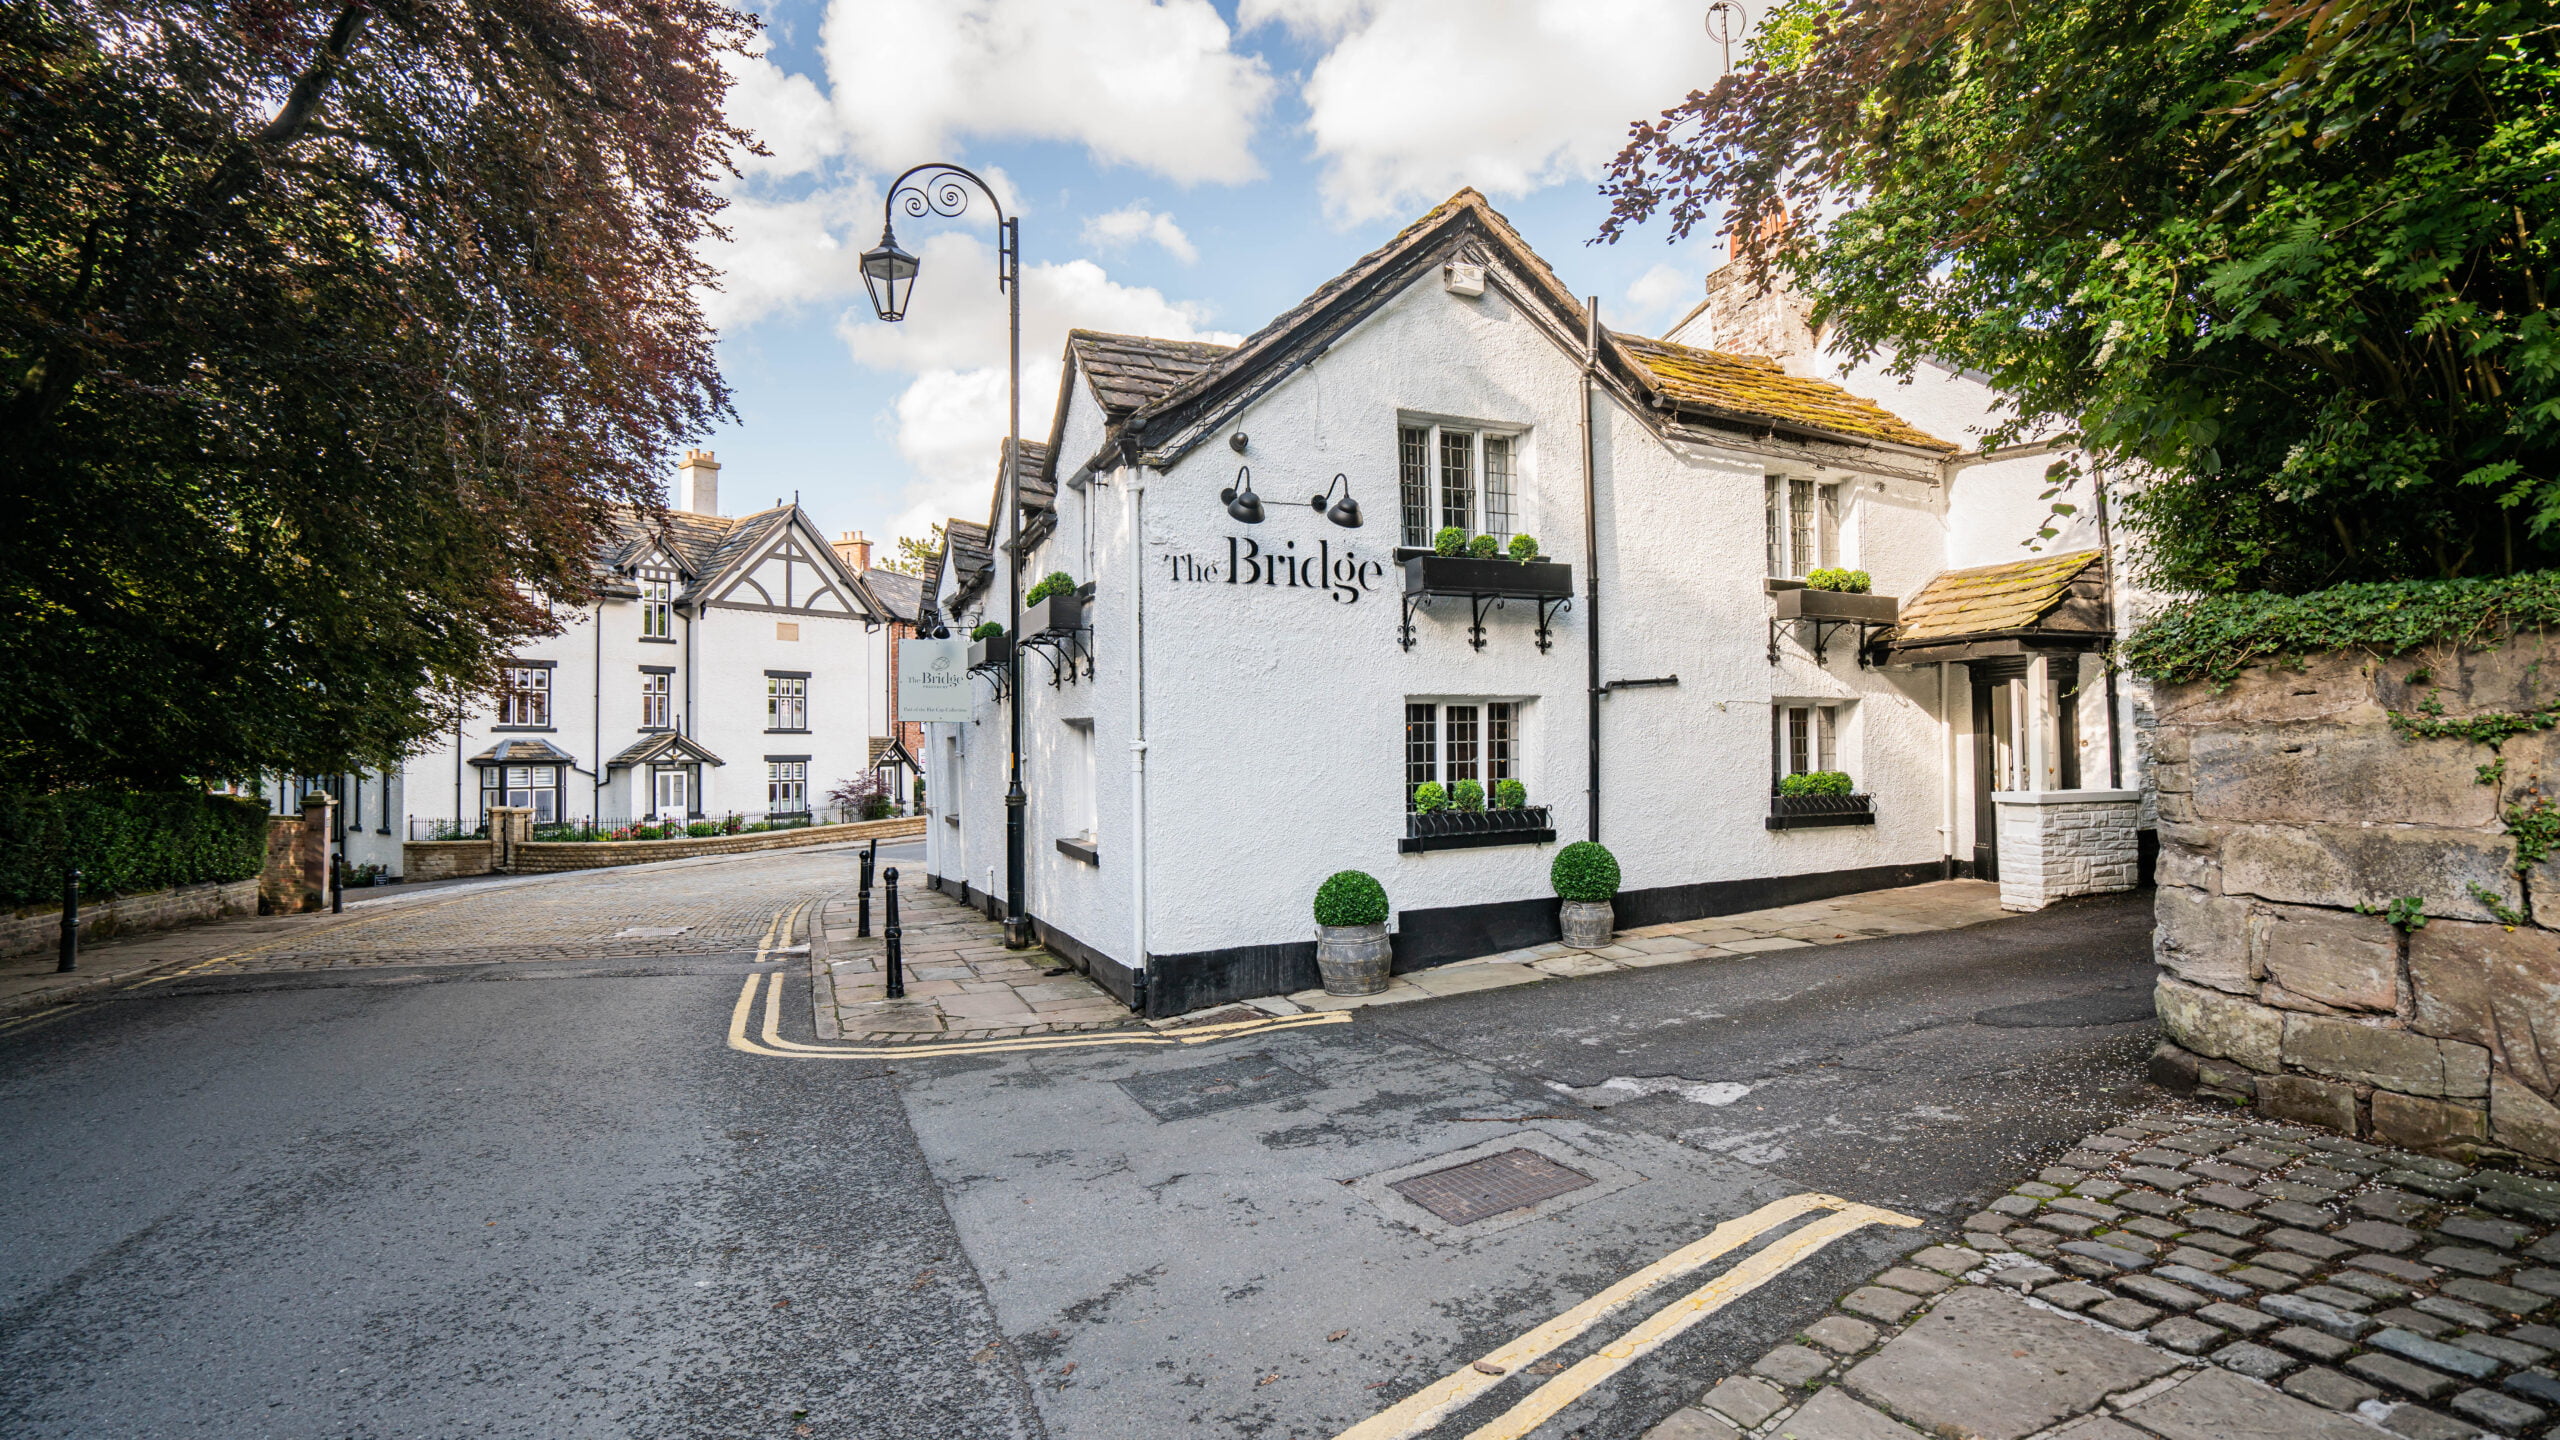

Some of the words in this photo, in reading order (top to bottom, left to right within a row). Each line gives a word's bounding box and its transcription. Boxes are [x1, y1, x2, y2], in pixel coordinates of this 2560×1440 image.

[1163, 554, 1218, 583] The
[1223, 536, 1383, 604] Bridge
[908, 676, 921, 684] The
[922, 672, 964, 687] Bridge
